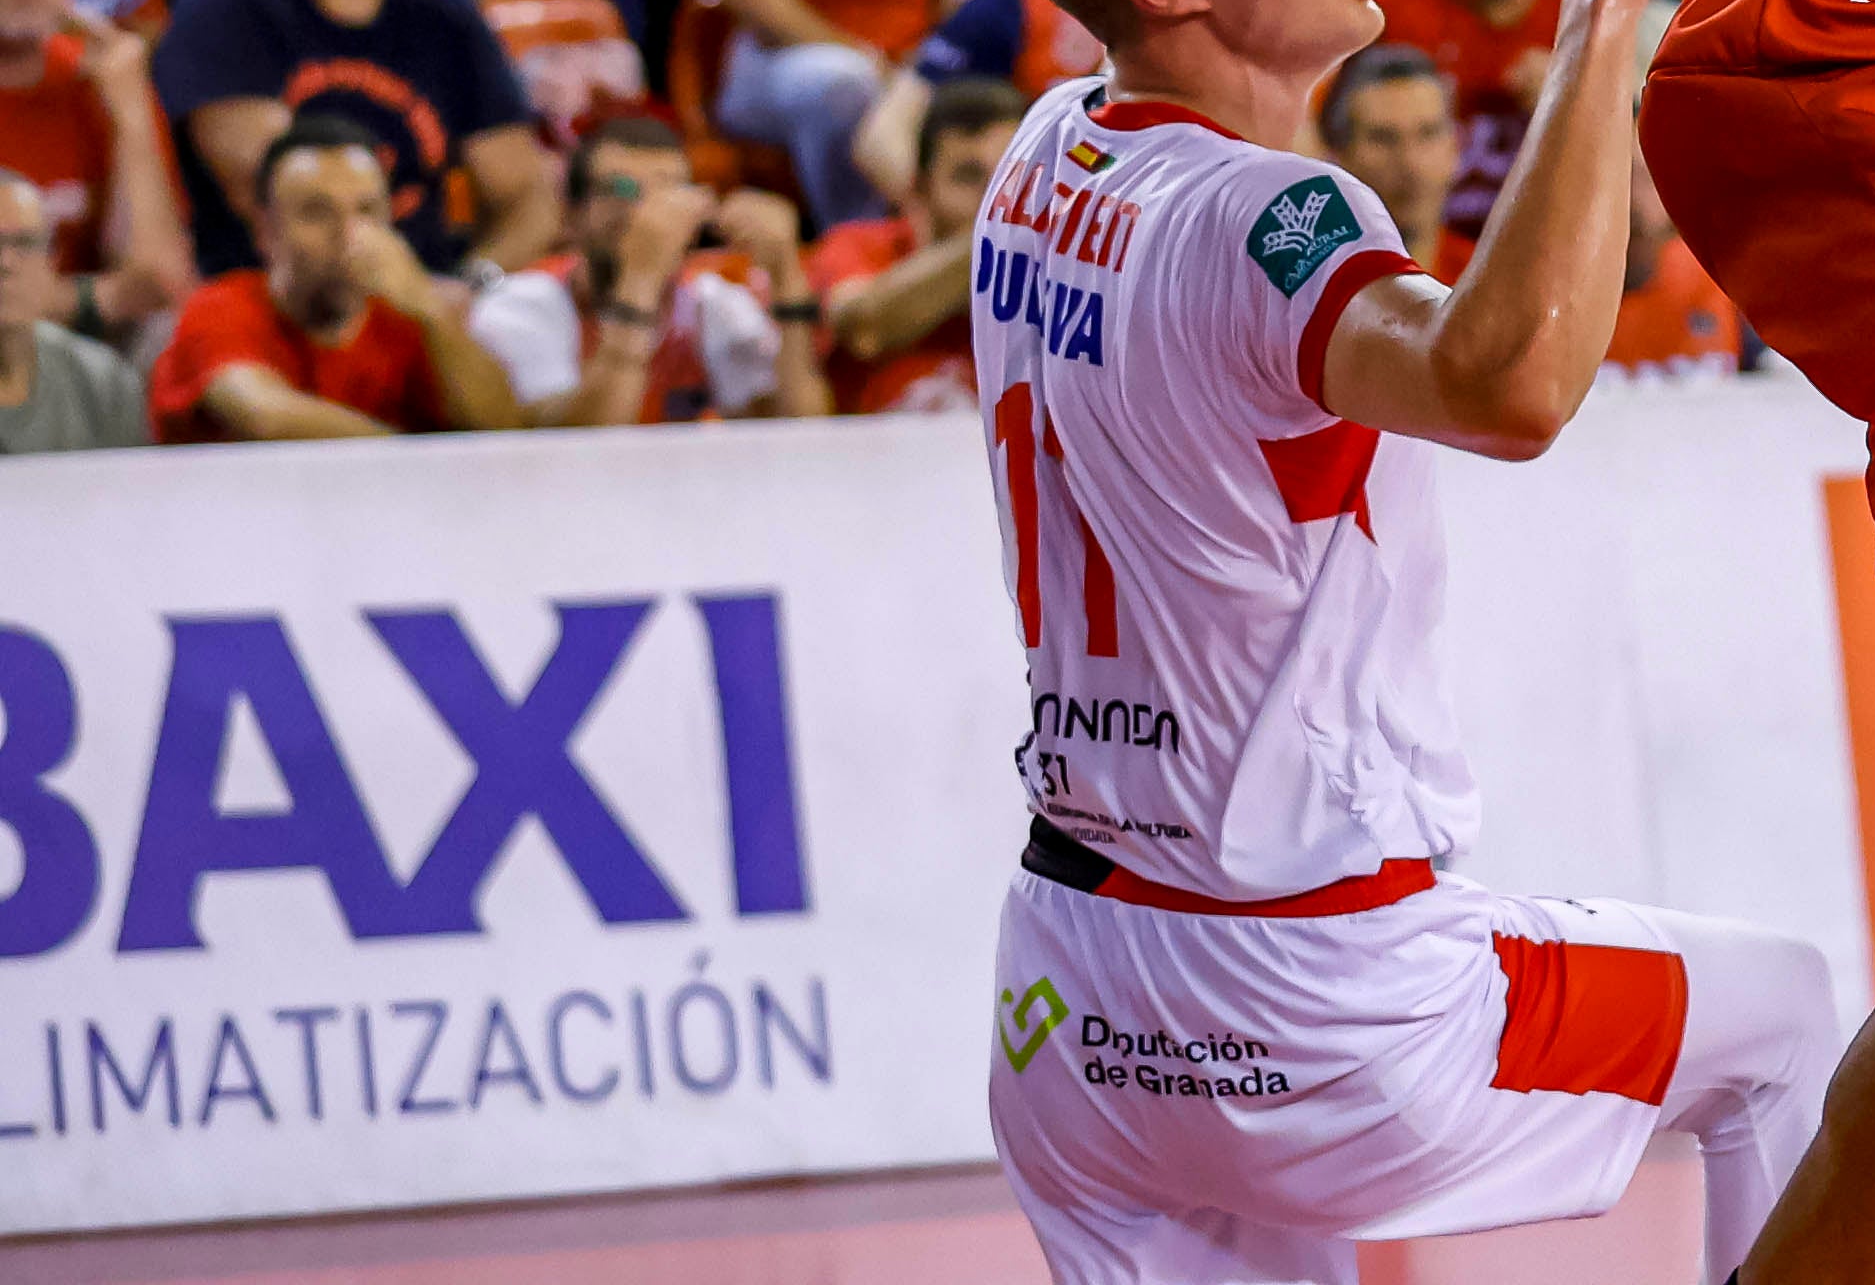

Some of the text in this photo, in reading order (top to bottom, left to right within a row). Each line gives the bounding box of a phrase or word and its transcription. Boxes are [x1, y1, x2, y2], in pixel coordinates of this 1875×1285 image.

[0, 947, 836, 1141] IMATIZACIÓN
[1081, 1015, 1269, 1063] Dputción
[1084, 1055, 1290, 1100] de Granada
